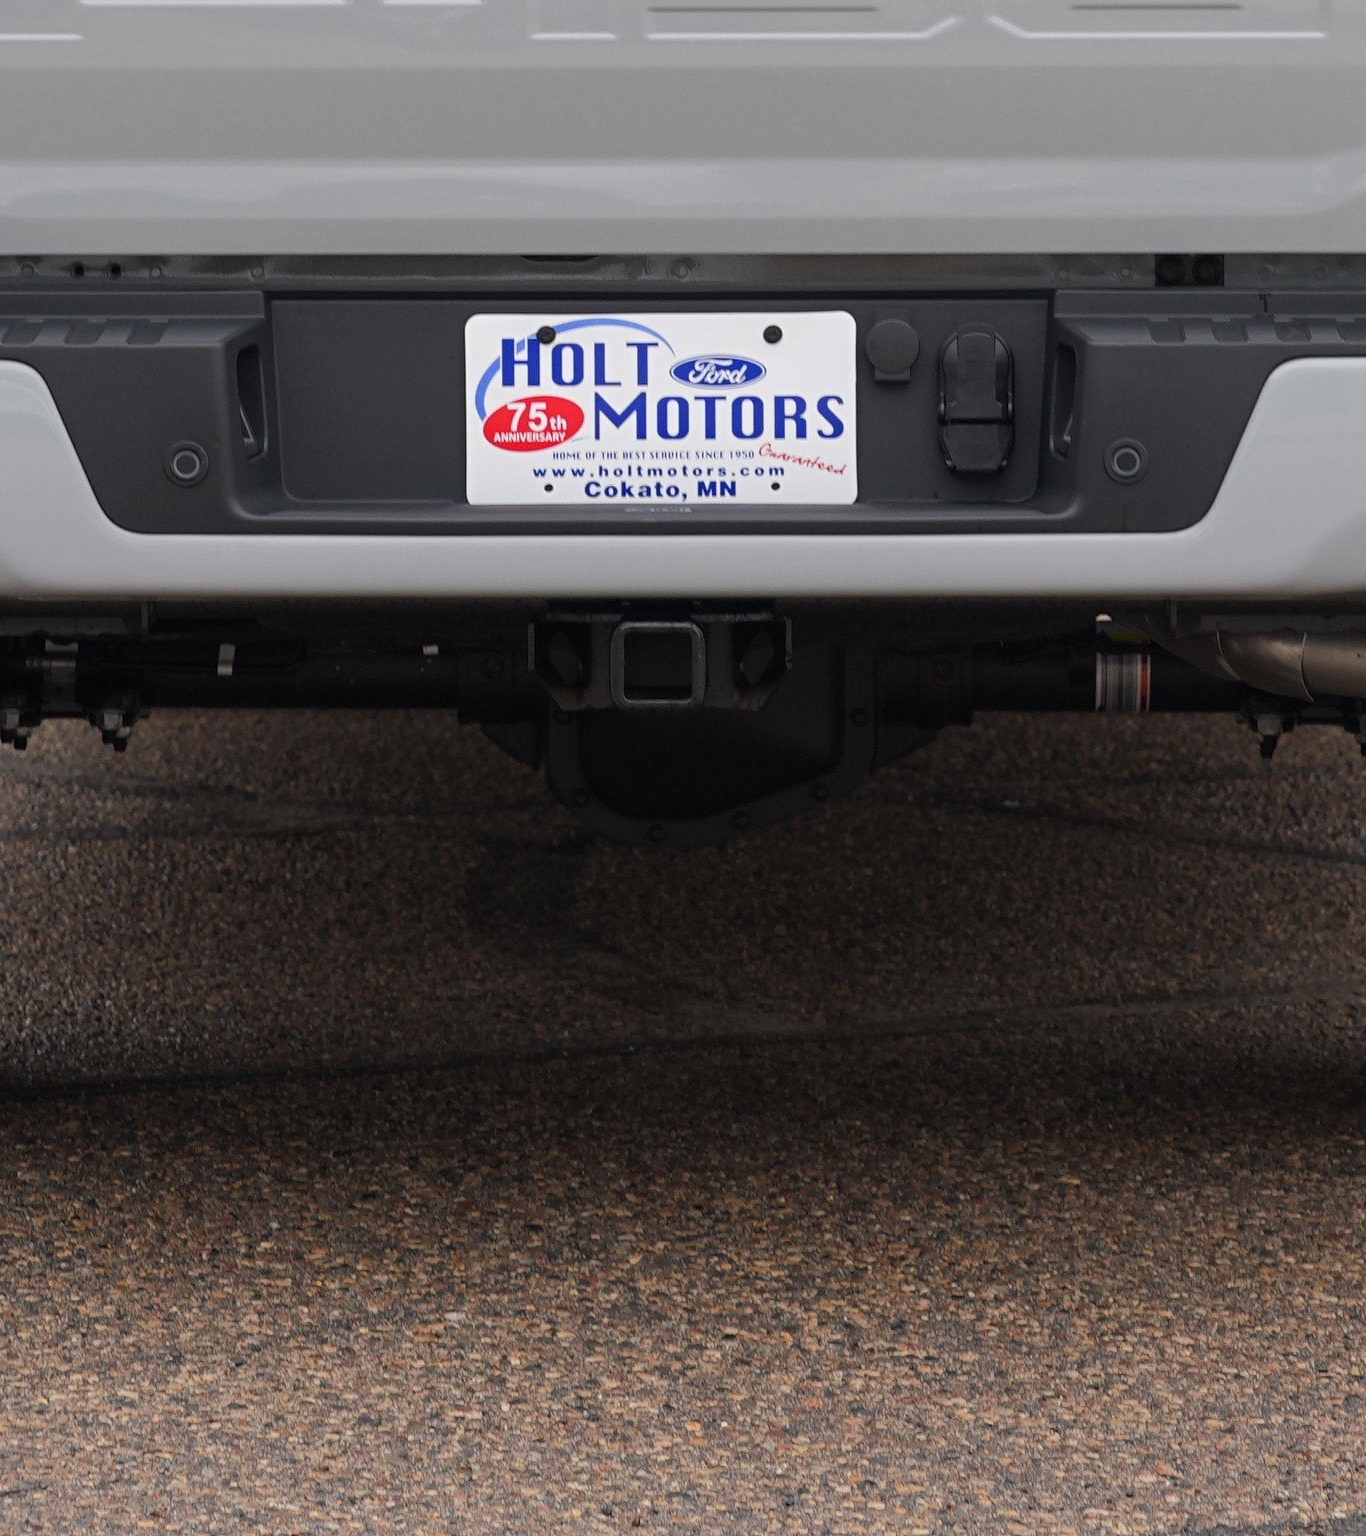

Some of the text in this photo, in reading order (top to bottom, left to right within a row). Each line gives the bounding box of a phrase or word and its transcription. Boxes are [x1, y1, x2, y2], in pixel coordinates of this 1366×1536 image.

[501, 338, 747, 386] HOLT Ford
[507, 401, 567, 433] 75th
[594, 391, 845, 441] MOTORS
[493, 431, 567, 443] ANNIVERSARY
[552, 451, 581, 460] HOME
[586, 451, 596, 460] OF
[601, 451, 618, 460] THE
[622, 451, 645, 460] BEST
[649, 451, 691, 460] SERVICE
[695, 450, 724, 460] SINCE
[758, 442, 848, 476] Guaranteed
[533, 465, 785, 479] www.holtmotors.com
[584, 480, 736, 501] Cokato, MN
